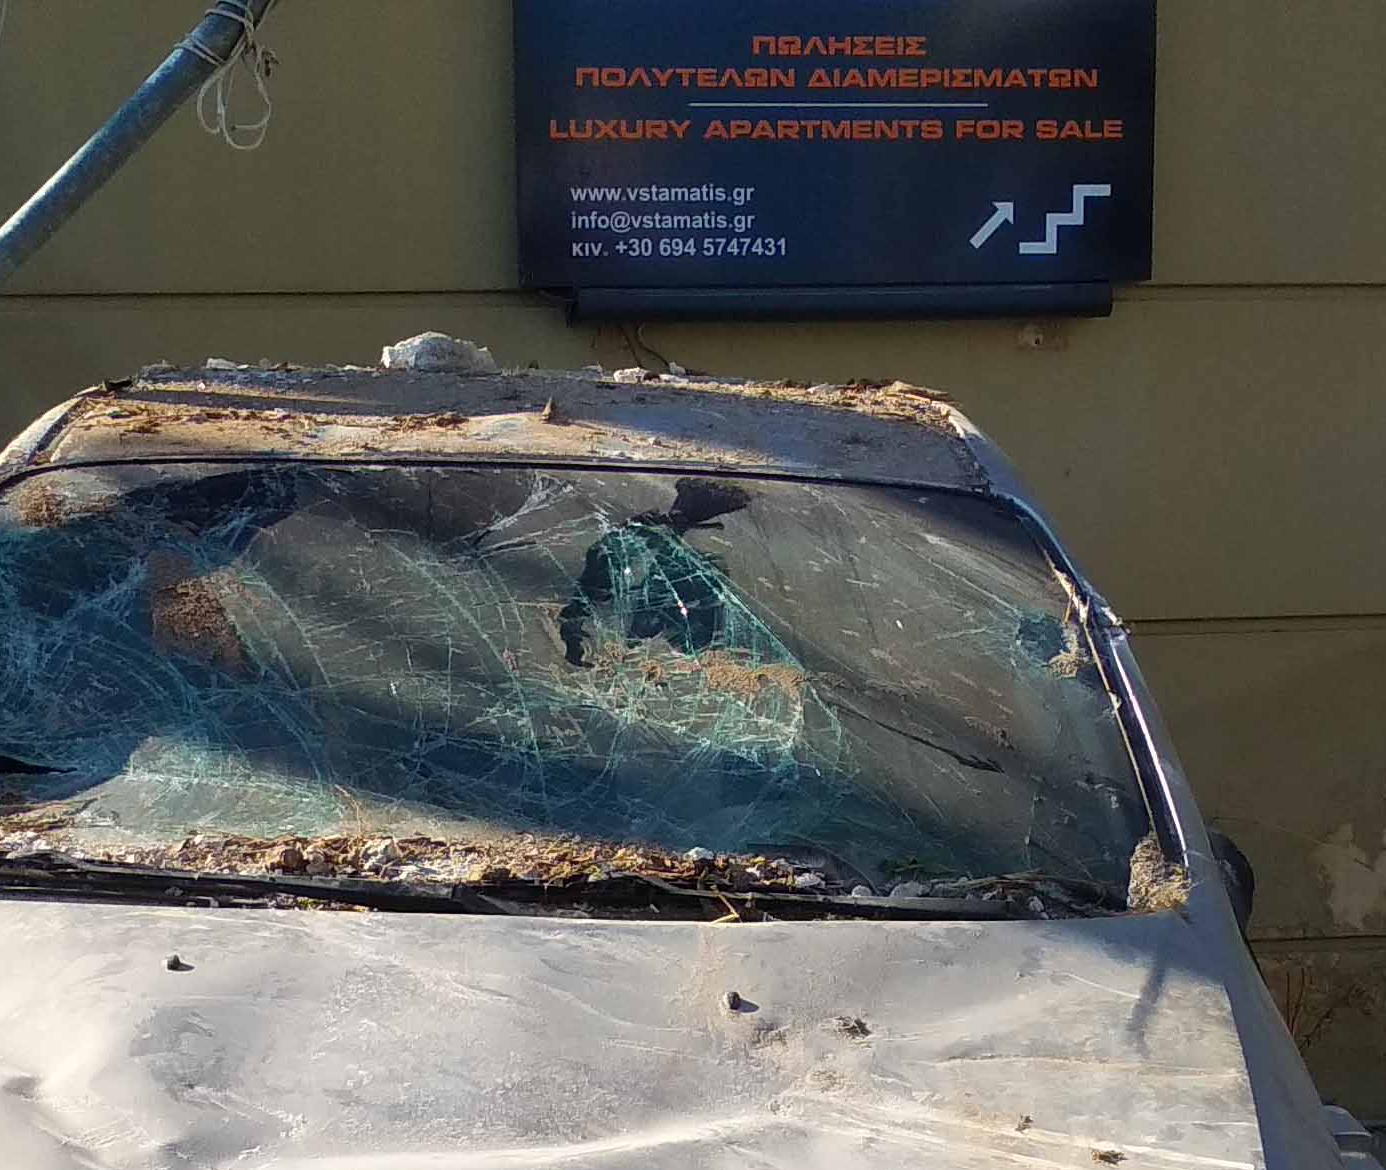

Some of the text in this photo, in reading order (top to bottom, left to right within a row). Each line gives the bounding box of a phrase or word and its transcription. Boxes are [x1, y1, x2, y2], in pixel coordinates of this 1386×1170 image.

[751, 35, 927, 56] ΠΩΛΗΣΕΙΣ
[575, 67, 1099, 89] ΠΟΛΥΤΕΛΩΝ ΔΙΑΜΕΡΙΣΜΑΤΩΝ
[549, 119, 1125, 141] LUXURY APARTMENTS FOR SALE
[570, 184, 755, 206] www.vstamatis.gr
[570, 211, 756, 234] info@vstamatis.gr
[615, 238, 653, 257] +30
[659, 238, 697, 257] 694
[703, 238, 788, 257] 5747431
